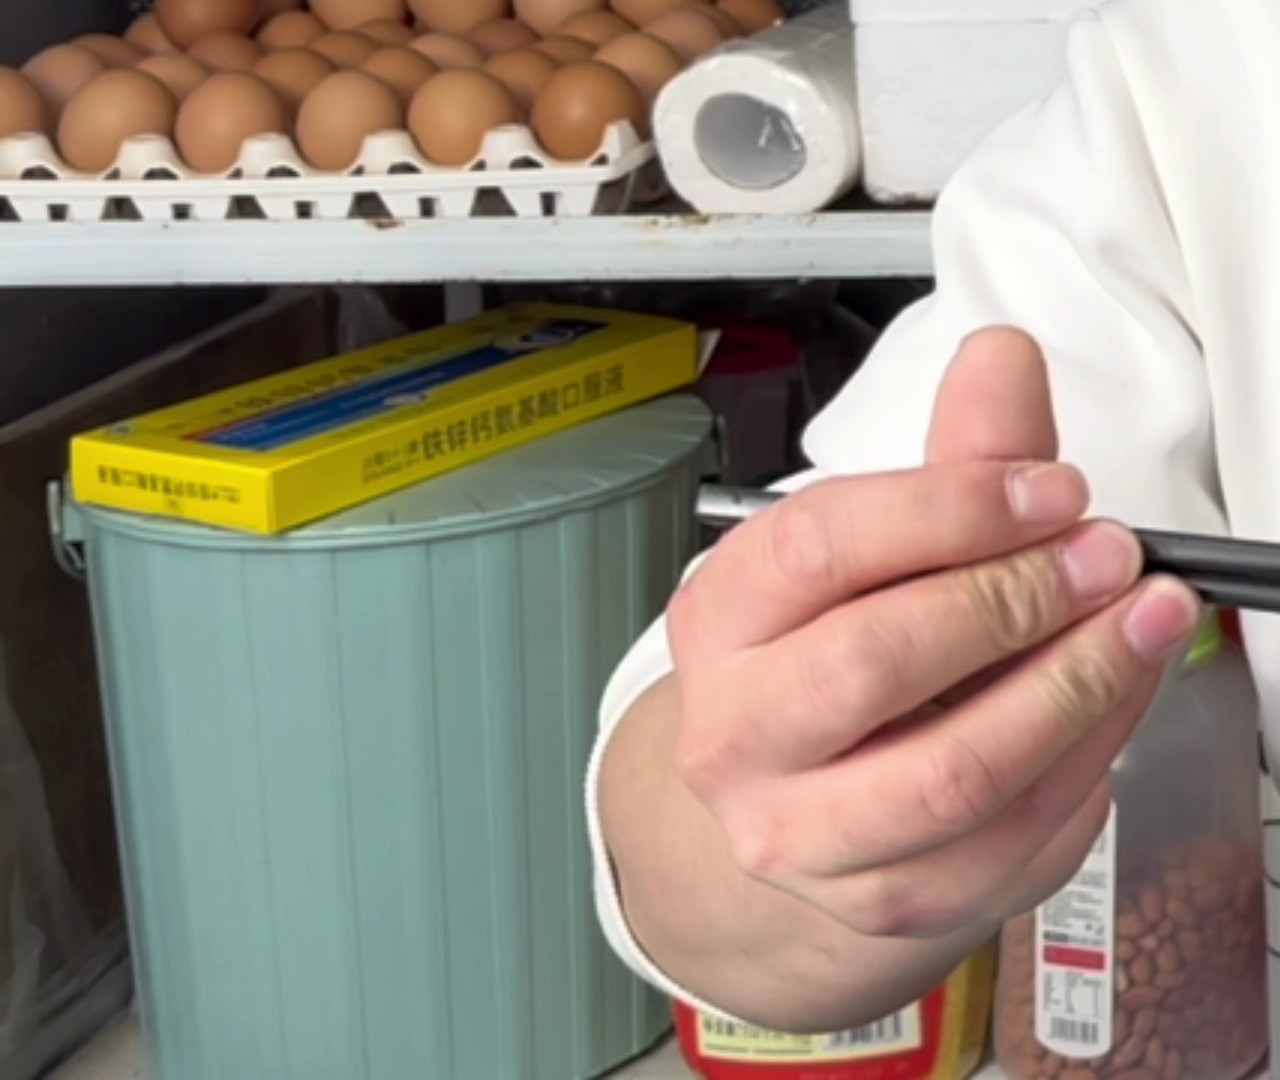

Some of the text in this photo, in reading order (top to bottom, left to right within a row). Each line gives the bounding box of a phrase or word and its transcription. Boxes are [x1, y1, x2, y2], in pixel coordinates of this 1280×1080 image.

[423, 364, 624, 460] 铁锌钙氨基酸口服液
